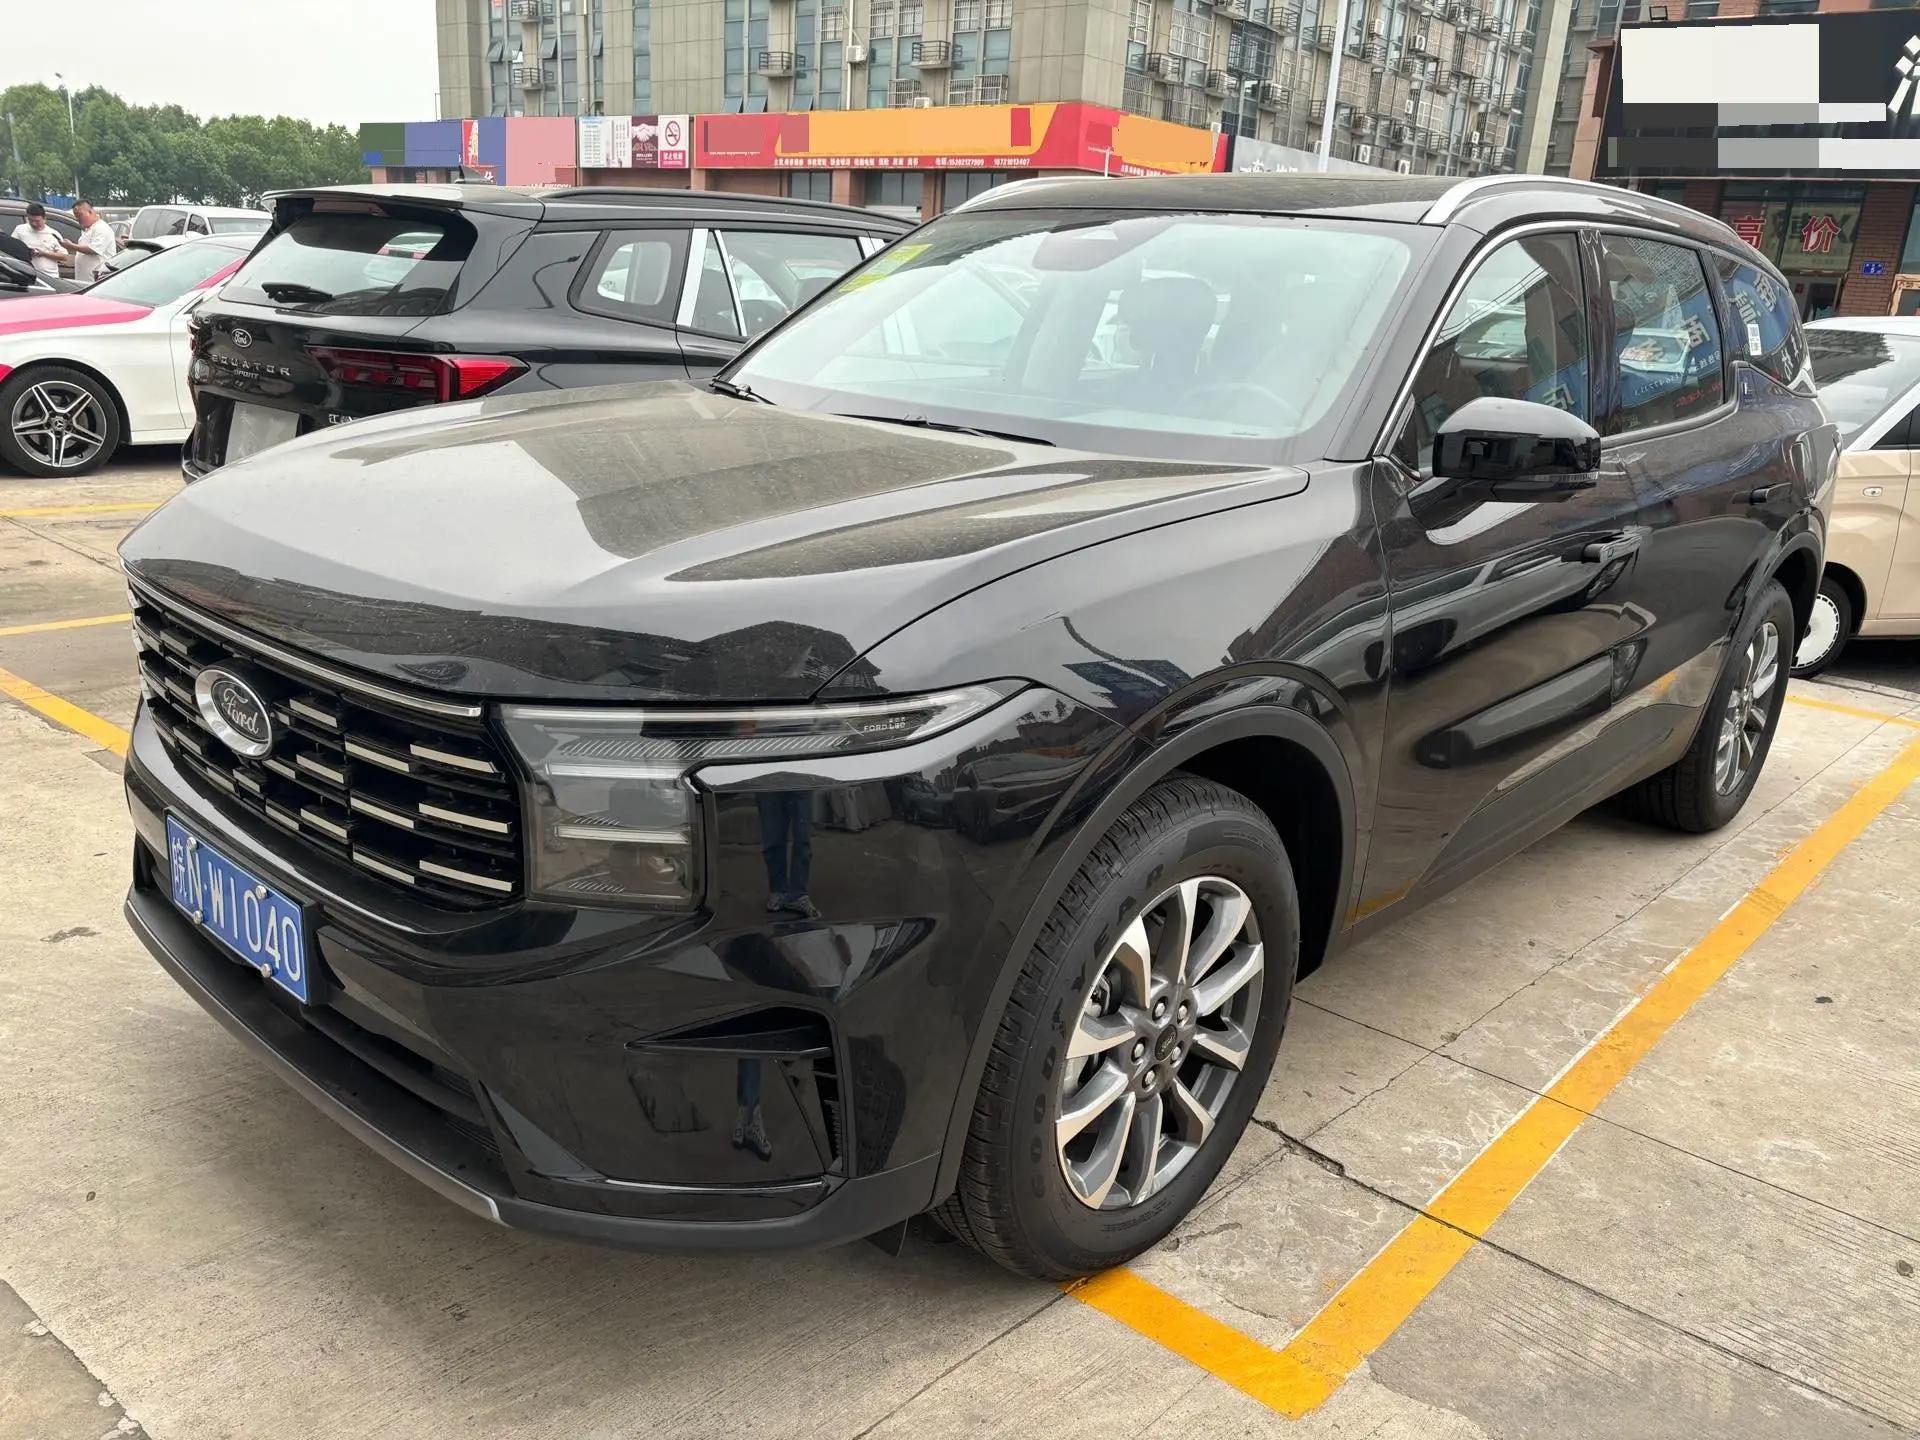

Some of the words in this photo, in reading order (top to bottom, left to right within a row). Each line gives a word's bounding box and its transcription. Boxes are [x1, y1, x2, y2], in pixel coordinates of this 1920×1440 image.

[211, 354, 291, 376] EQUATOR
[234, 369, 260, 379] SPORT
[221, 687, 260, 735] Ford
